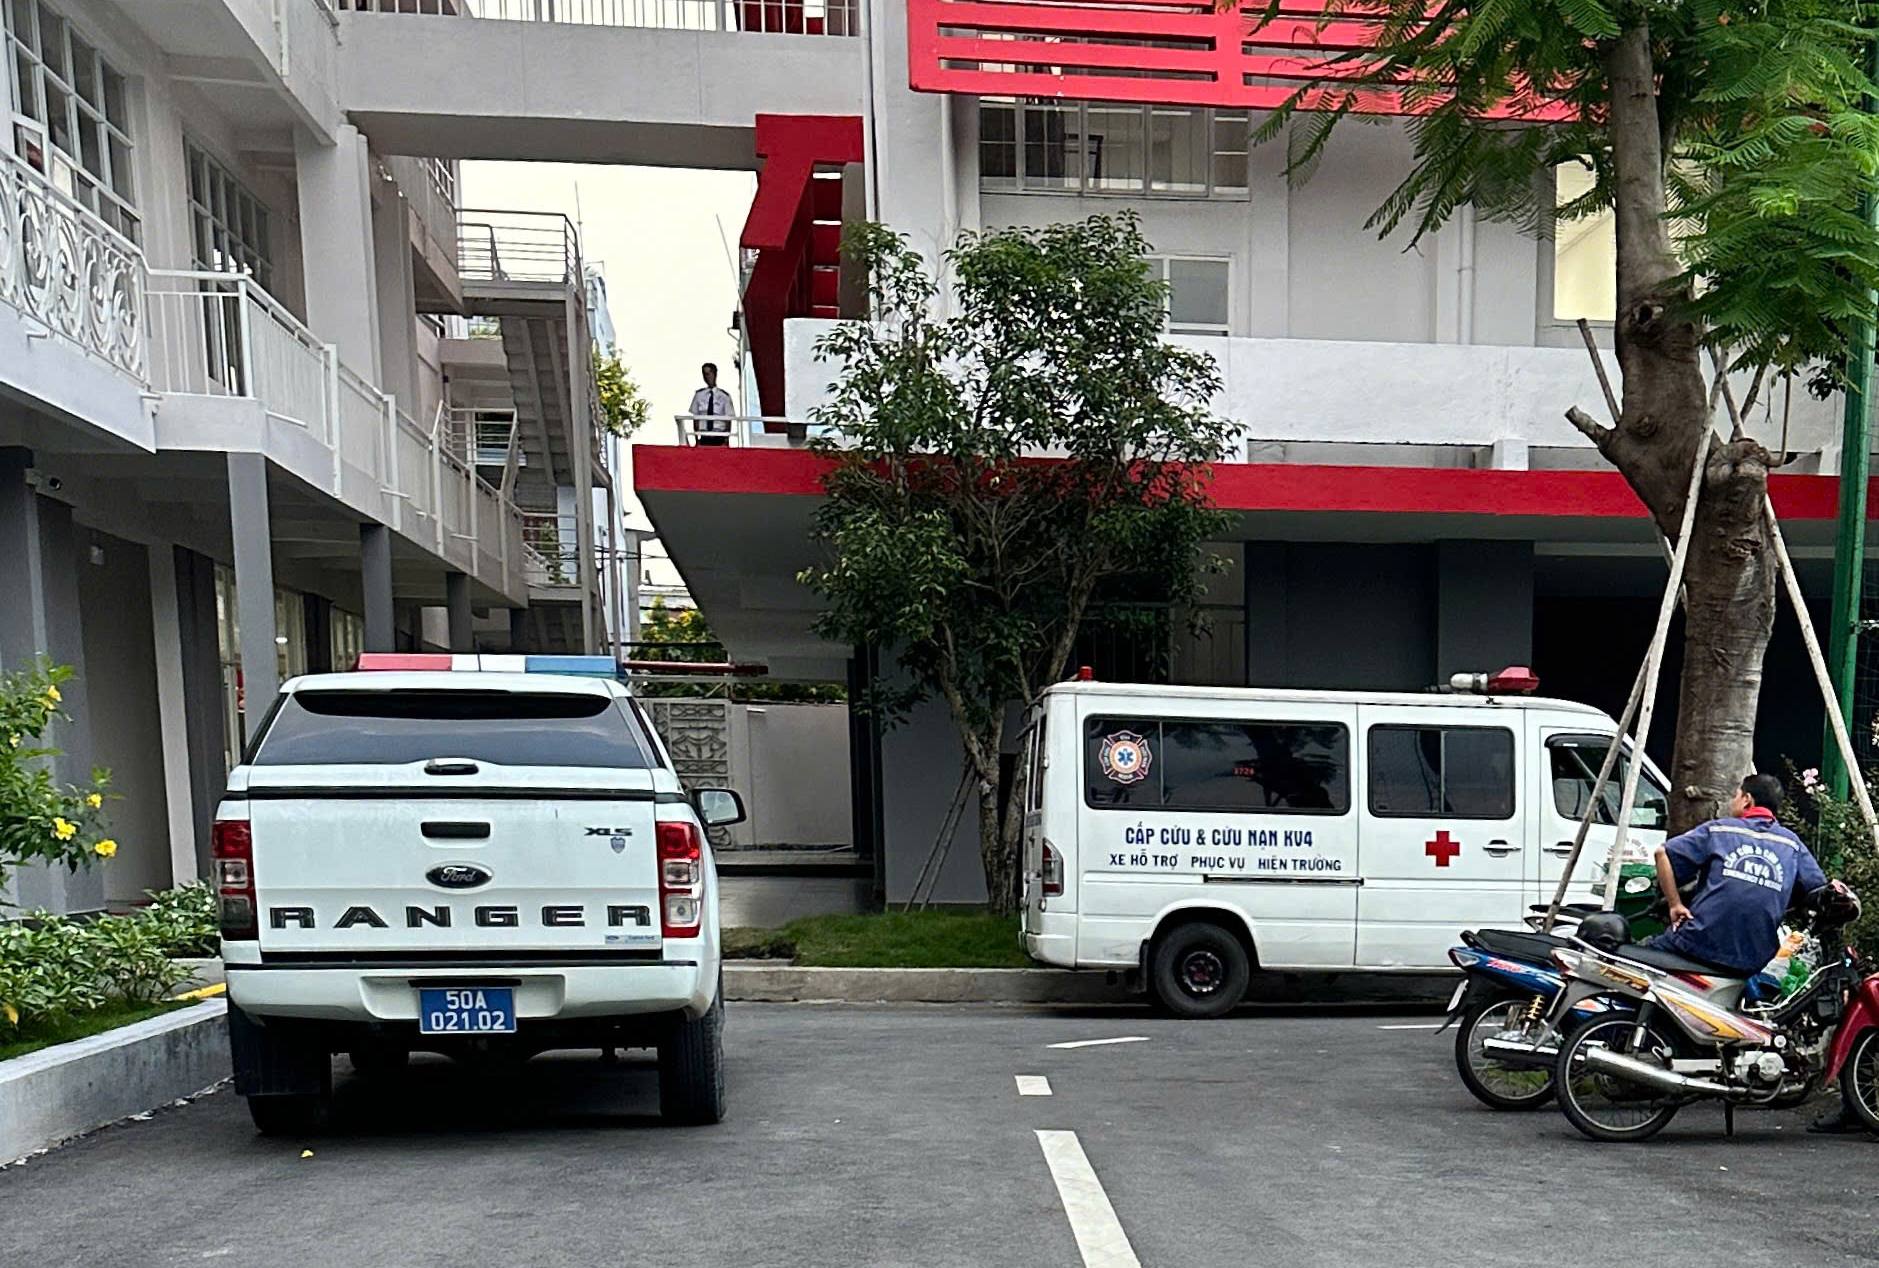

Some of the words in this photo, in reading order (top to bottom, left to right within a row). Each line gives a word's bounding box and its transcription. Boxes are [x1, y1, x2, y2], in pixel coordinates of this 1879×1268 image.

[584, 827, 633, 836] XLS
[1125, 821, 1155, 844] CẤP
[1160, 824, 1191, 845] CỨU
[1196, 828, 1206, 846] &
[1212, 825, 1242, 846] CỨU
[1248, 829, 1278, 850] NẠN
[1109, 853, 1126, 866] XE
[1130, 848, 1148, 866] HỖ
[1152, 853, 1179, 870] TRỢ
[1191, 856, 1225, 871] PHỤC
[1229, 857, 1246, 872] VỤ
[1258, 855, 1288, 873] HIỆN
[1291, 853, 1342, 871] TRƯỜNG
[440, 866, 477, 882] Ford
[269, 905, 651, 928] RANGER
[446, 990, 487, 1010] 50A
[431, 1011, 505, 1030] 021.02
